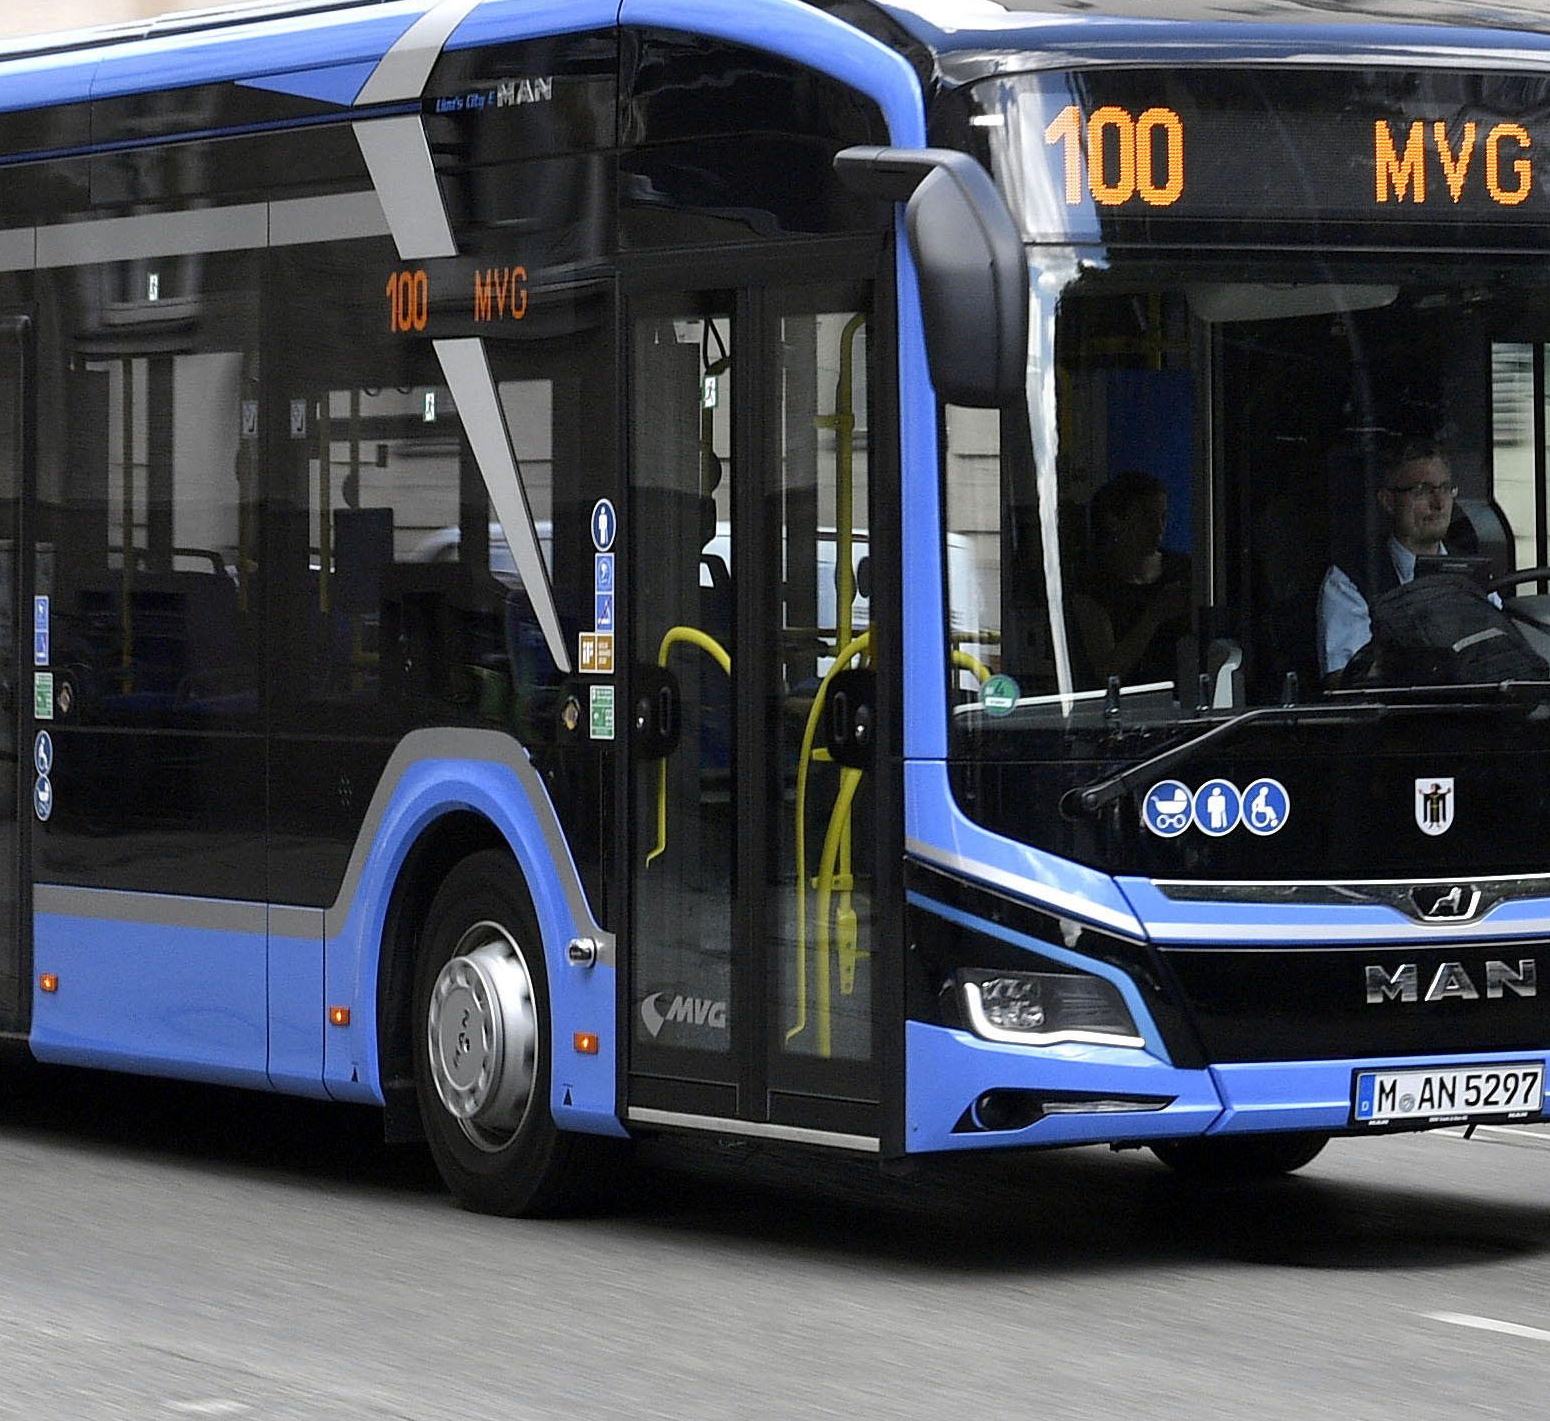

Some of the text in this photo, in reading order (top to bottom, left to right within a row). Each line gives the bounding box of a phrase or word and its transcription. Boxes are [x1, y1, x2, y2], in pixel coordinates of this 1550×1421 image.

[496, 76, 554, 109] MAN
[1044, 105, 1532, 206] 100 MVG
[385, 265, 528, 333] 100 MVG
[1365, 959, 1537, 1004] MAN
[665, 995, 726, 1028] MVG
[1378, 1078, 1397, 1112] M
[1417, 1075, 1457, 1111] AN
[1464, 1071, 1539, 1107] 5297
